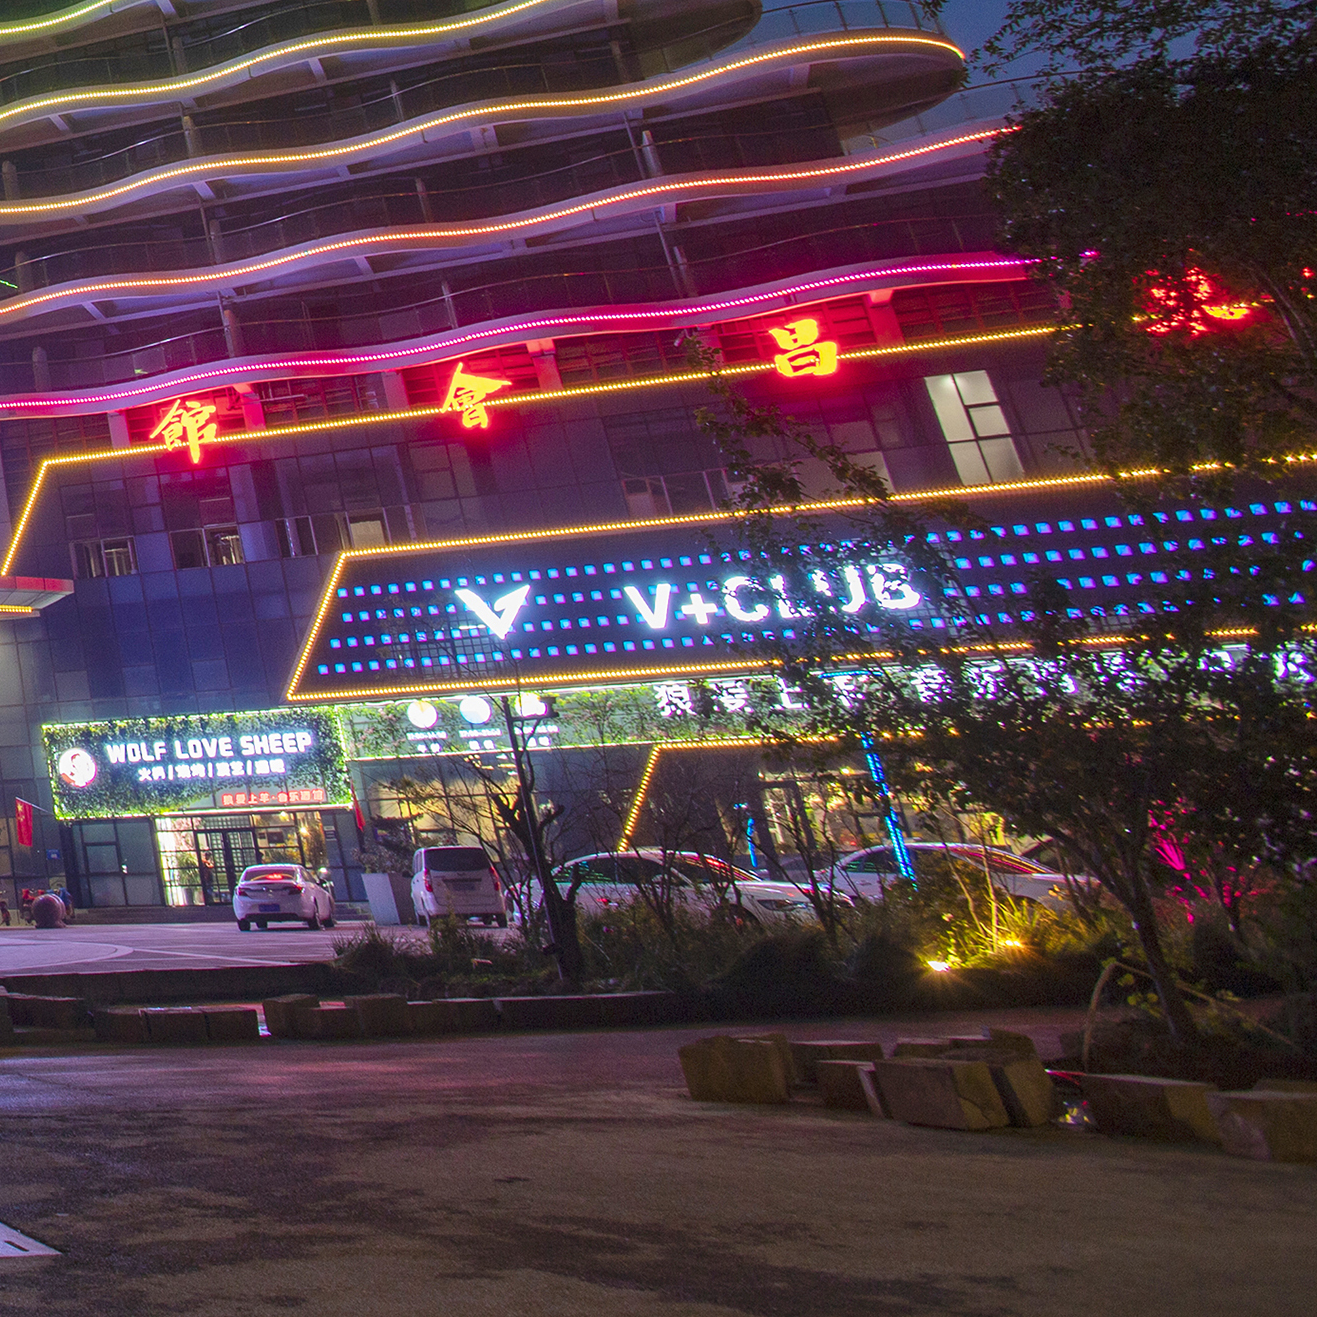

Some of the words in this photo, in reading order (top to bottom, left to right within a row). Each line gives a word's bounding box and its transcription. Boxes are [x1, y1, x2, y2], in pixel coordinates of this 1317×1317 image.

[106, 740, 167, 765] WOLF
[175, 736, 235, 761] LOVE
[240, 731, 313, 757] SHEEP
